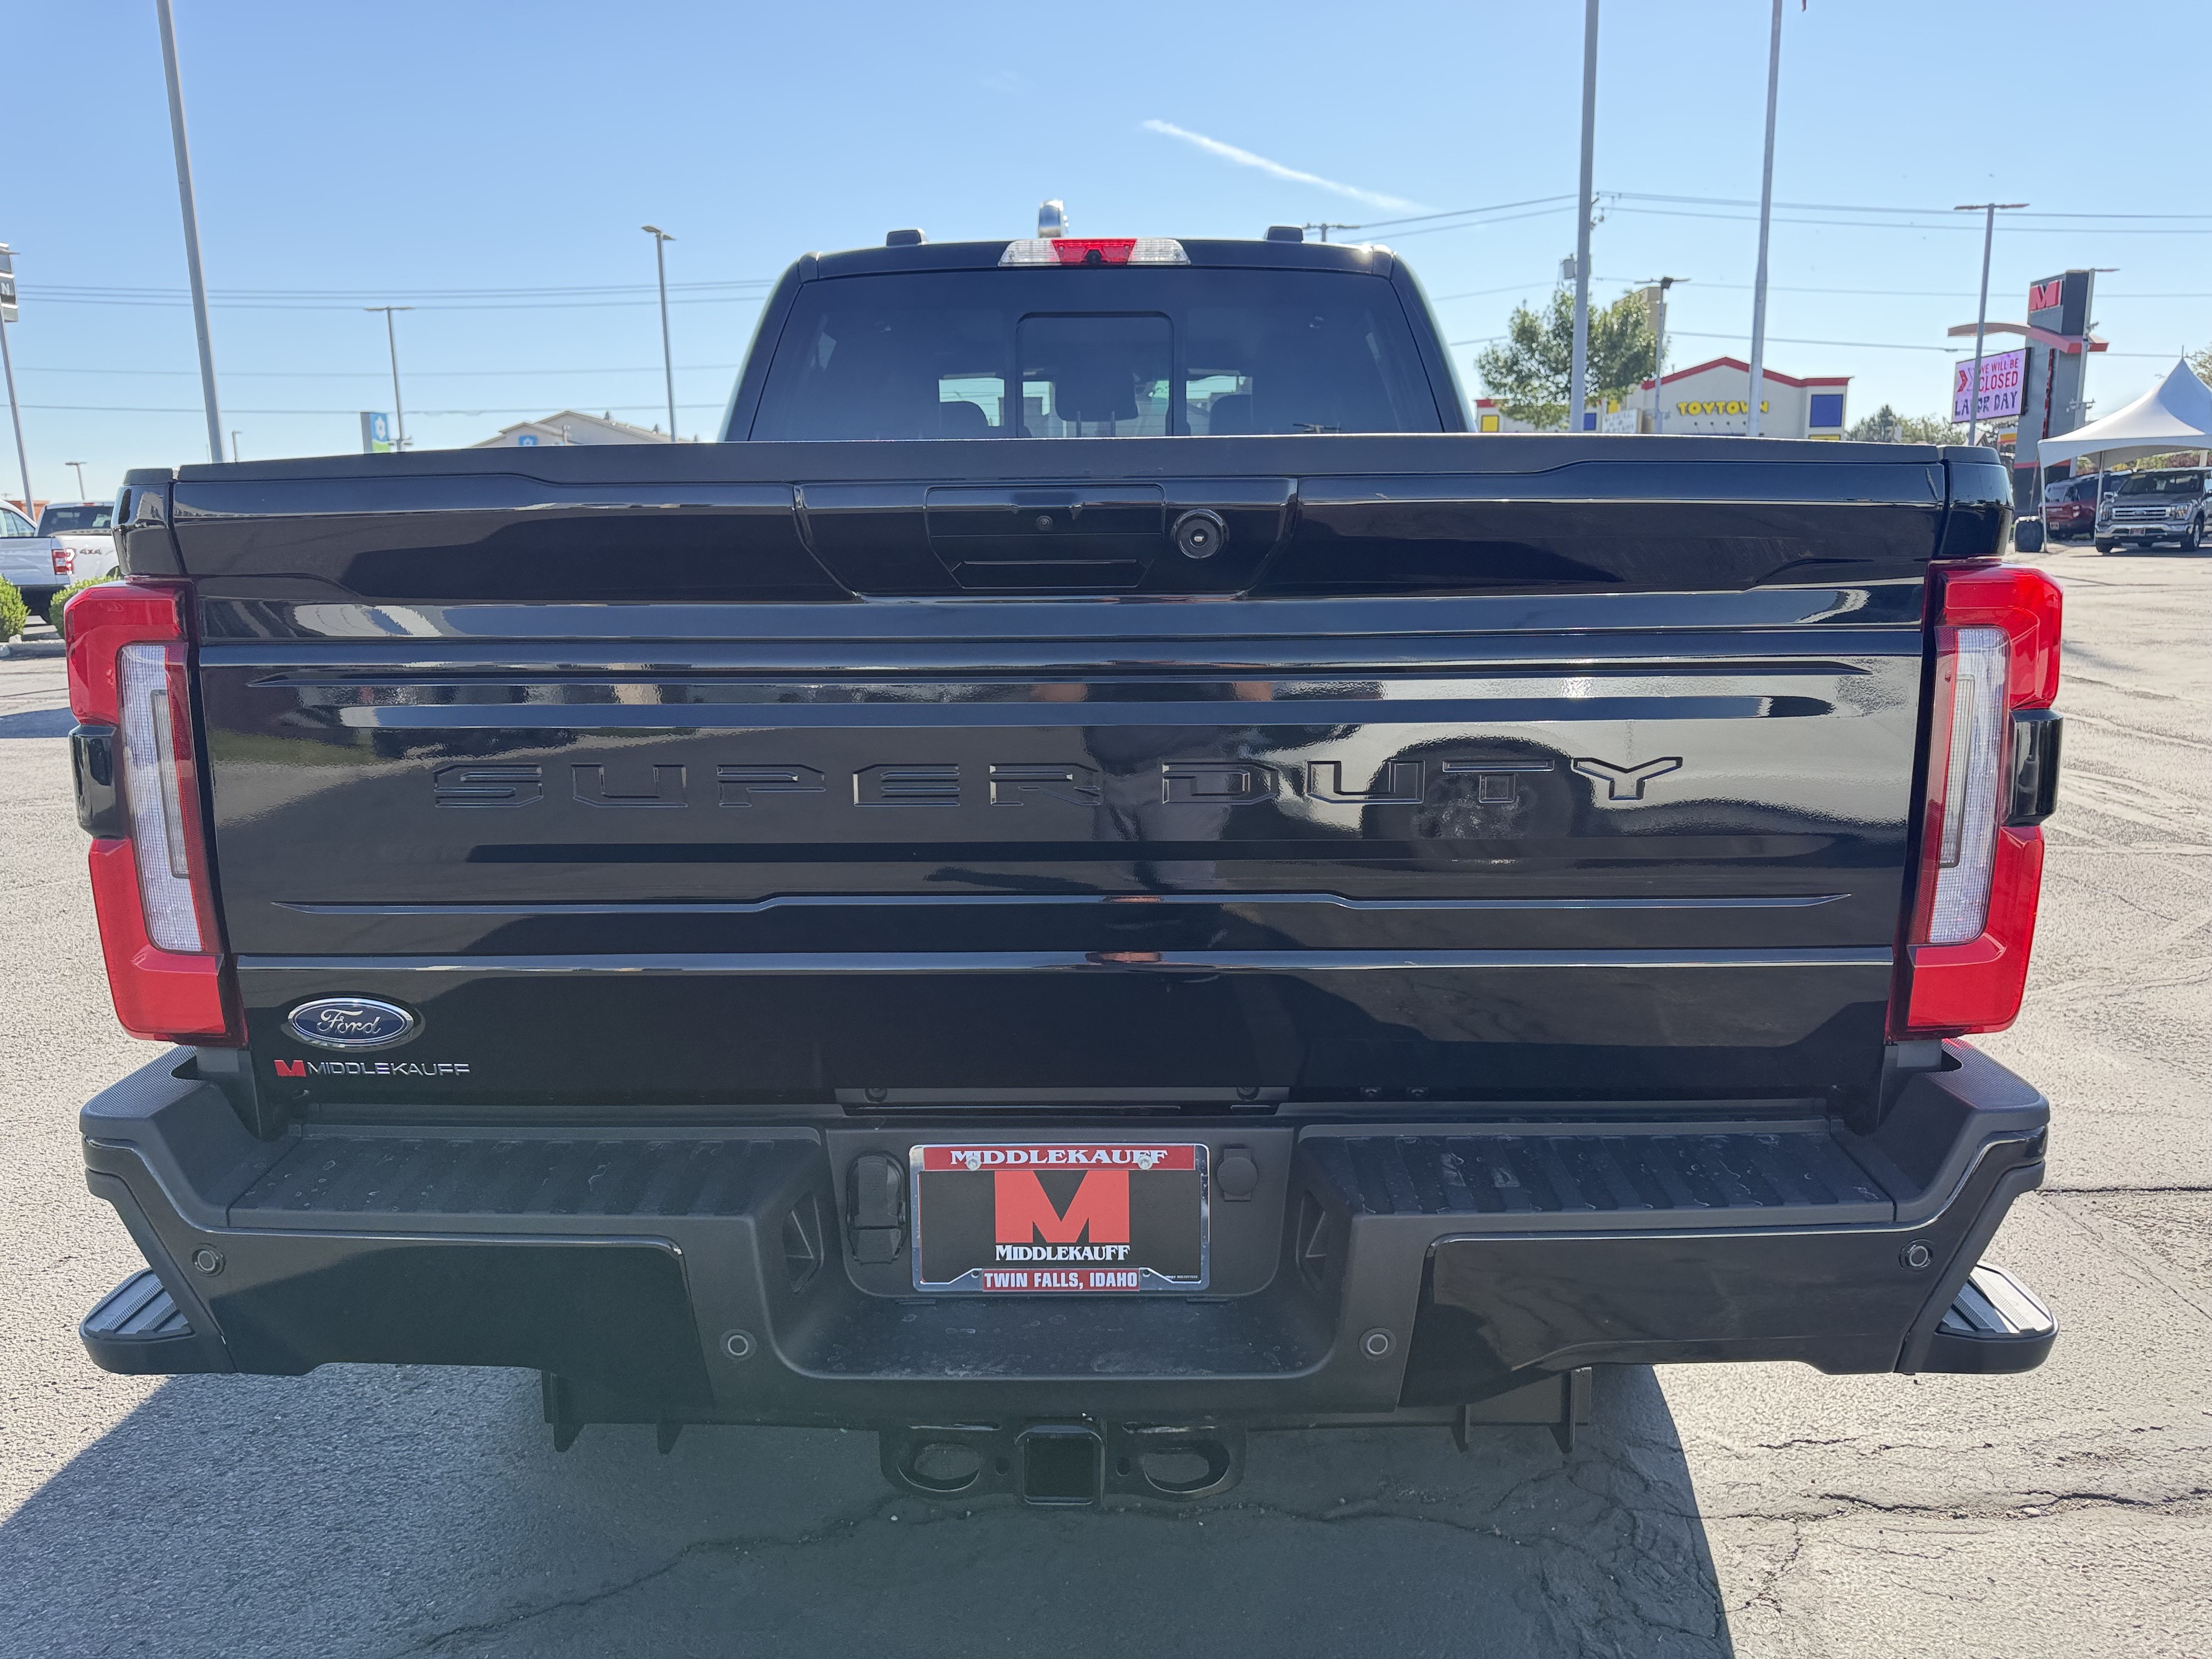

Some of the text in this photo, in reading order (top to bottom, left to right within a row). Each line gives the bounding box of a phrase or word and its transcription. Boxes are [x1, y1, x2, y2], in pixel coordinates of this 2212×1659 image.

[2029, 280, 2062, 313] M
[1991, 360, 2007, 373] WILL
[2010, 358, 2019, 369] BE
[1979, 371, 2018, 392] CLOSED
[1955, 391, 2018, 416] LAOR DAY
[433, 757, 1683, 809] SUPER DUTY
[317, 1008, 381, 1035] Ford
[307, 1062, 470, 1076] MIDDLEKAUFF
[994, 1170, 1130, 1243] M
[995, 1245, 1131, 1261] MIDDLEKAUFF
[984, 1272, 1137, 1289] TWIN FALLS, IDAHO
